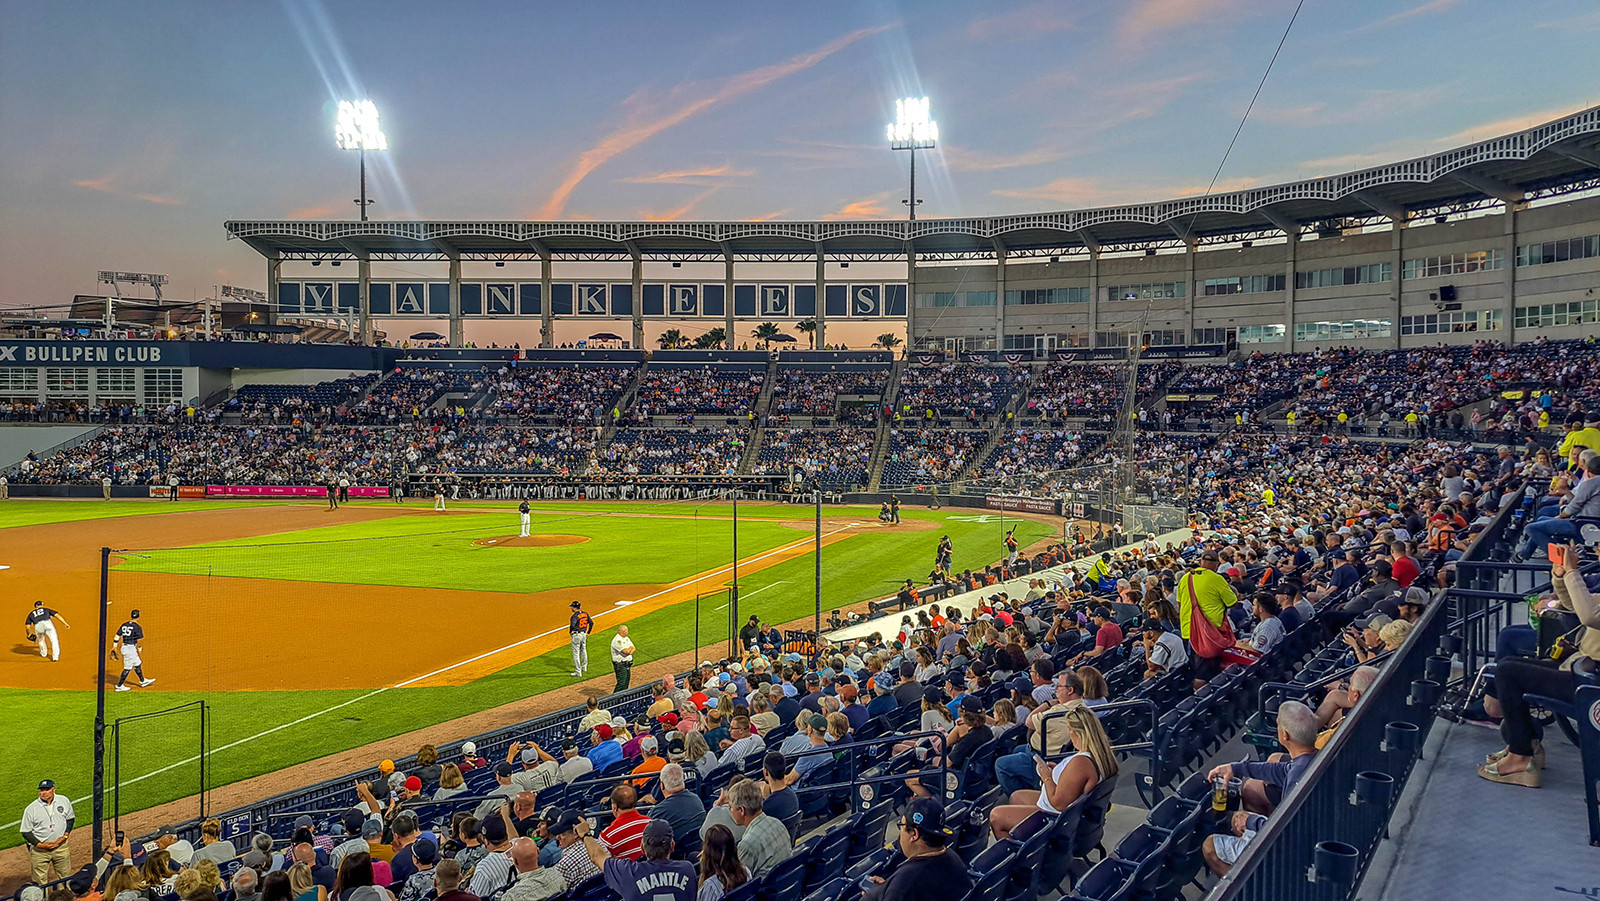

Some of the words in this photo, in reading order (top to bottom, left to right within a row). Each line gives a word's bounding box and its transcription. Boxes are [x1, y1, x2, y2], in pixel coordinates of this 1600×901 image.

[25, 346, 108, 362] BULLPEN
[115, 346, 161, 362] CLUB
[32, 608, 44, 618] 12
[121, 626, 134, 637] 95
[636, 872, 690, 895] MANTLE
